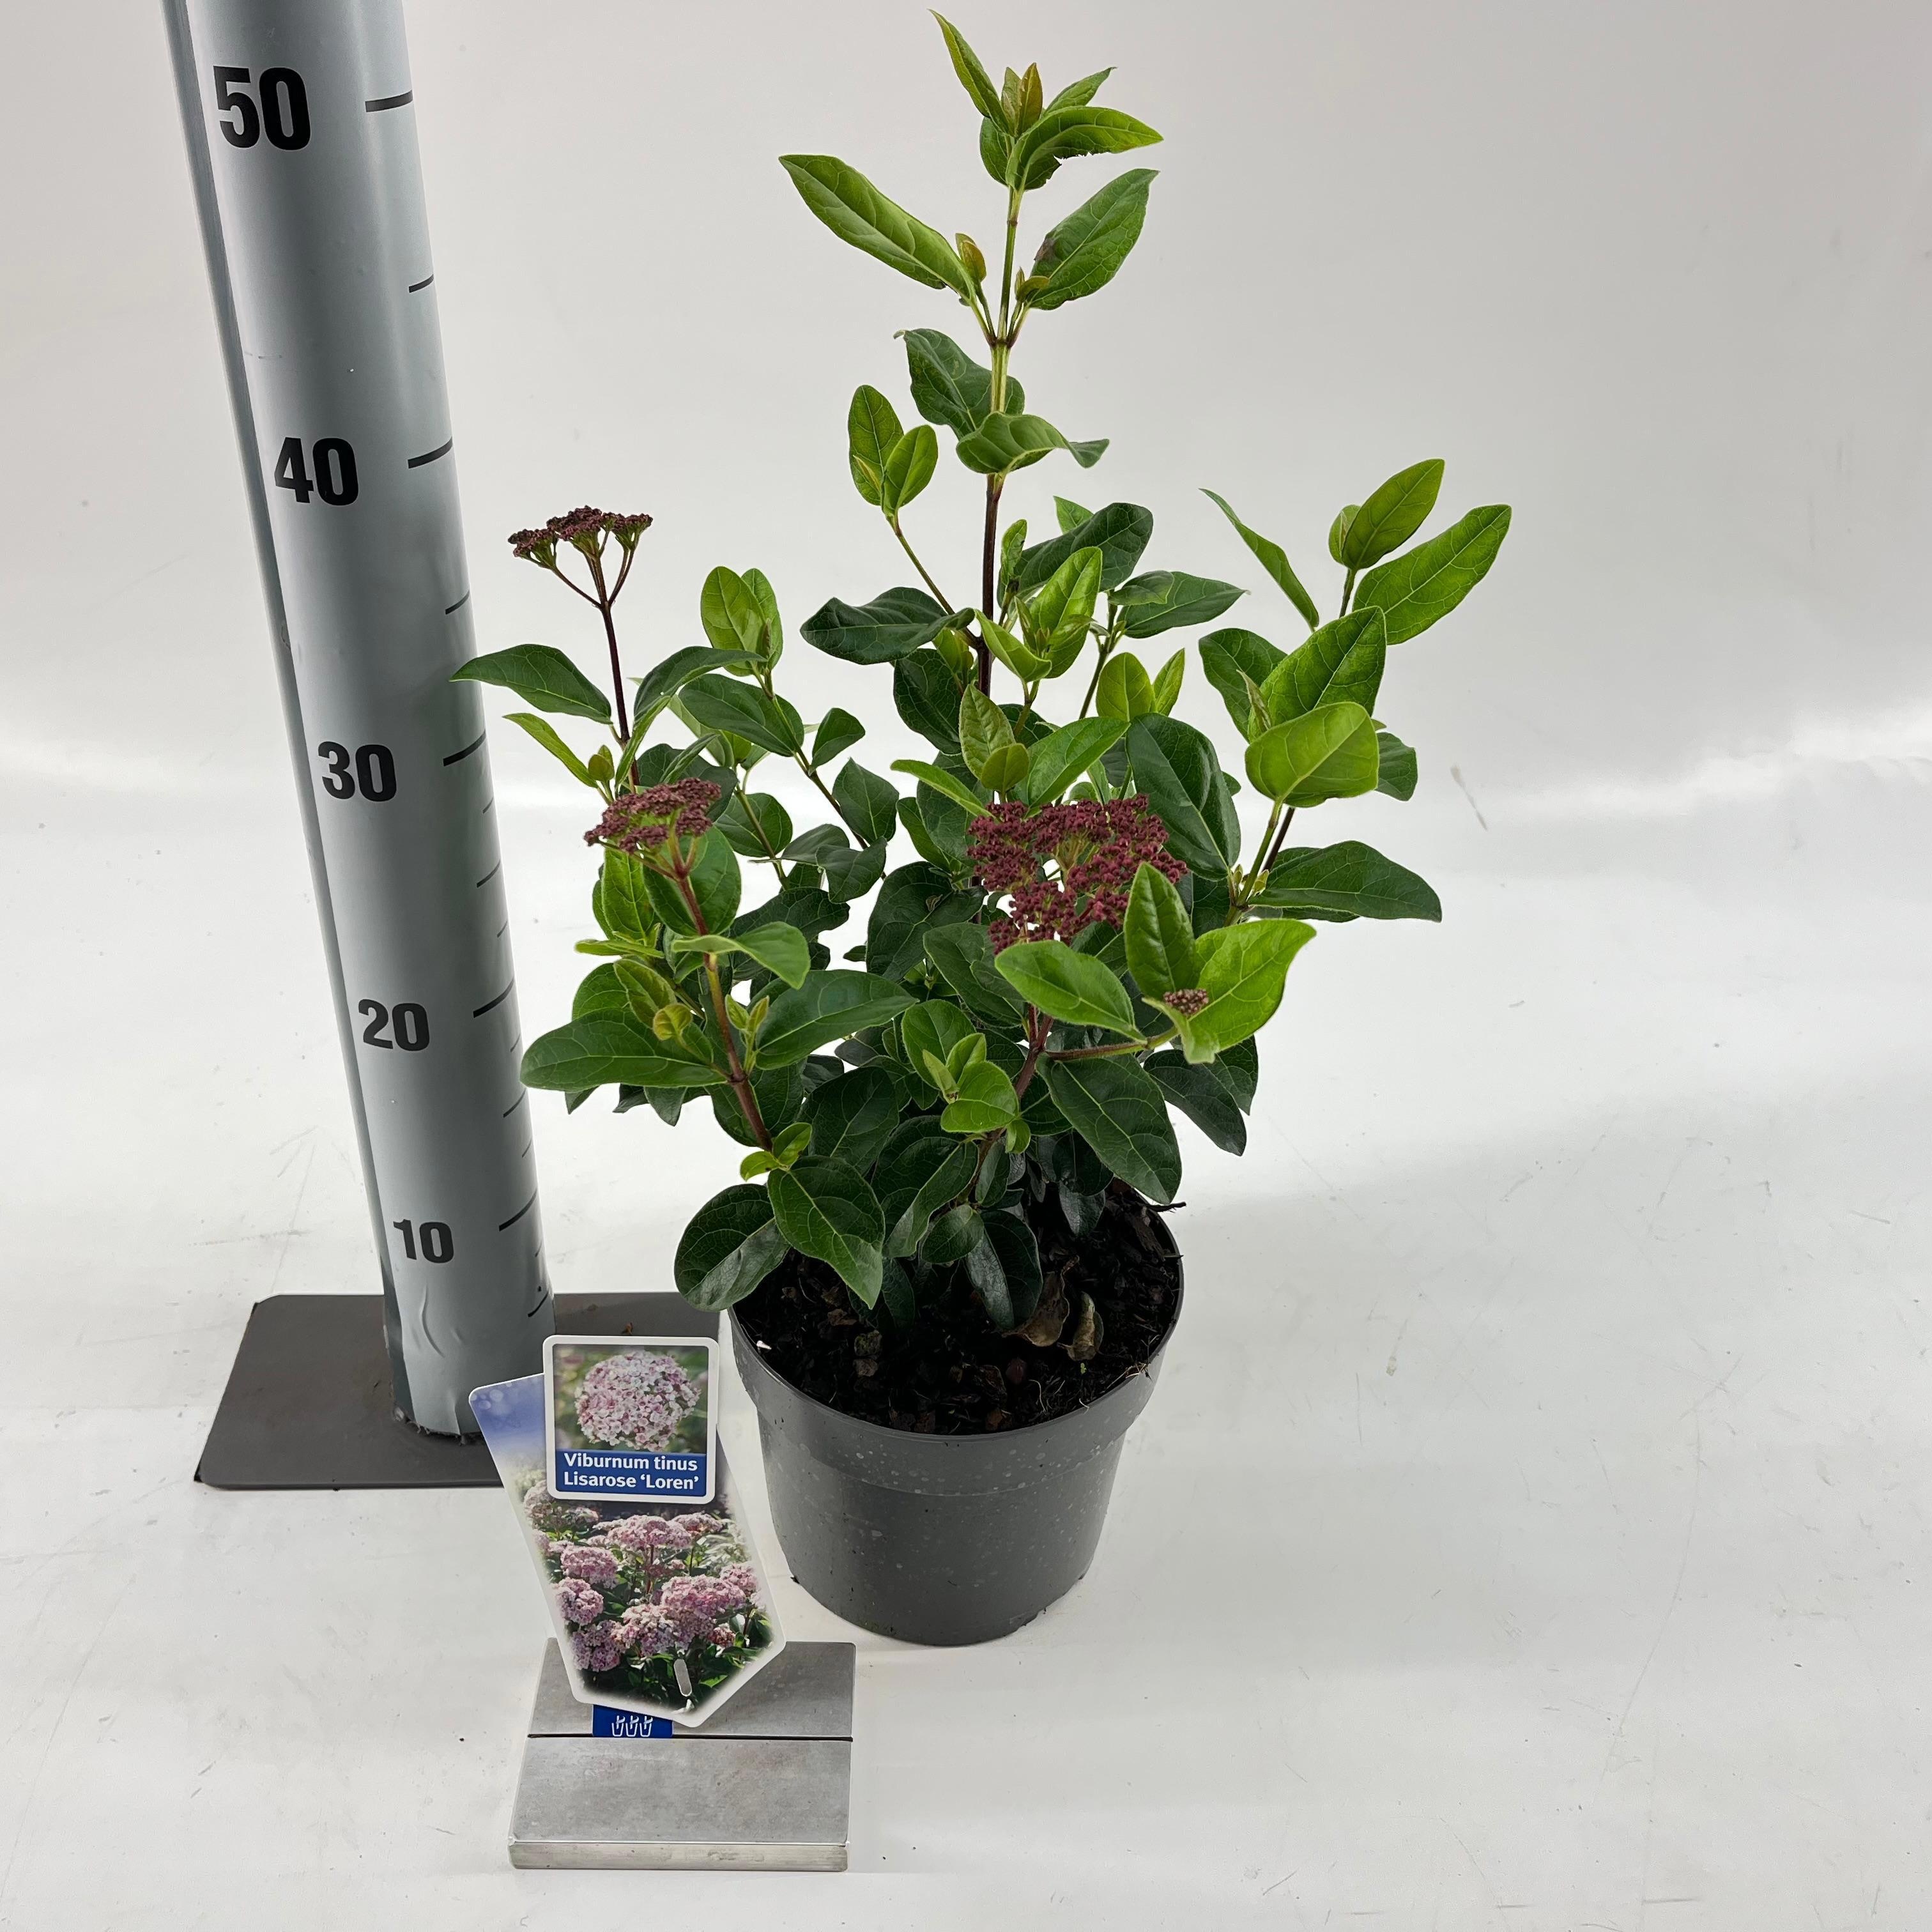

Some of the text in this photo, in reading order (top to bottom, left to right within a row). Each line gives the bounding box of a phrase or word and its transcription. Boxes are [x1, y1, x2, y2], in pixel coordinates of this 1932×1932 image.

[212, 66, 311, 151] 50
[275, 437, 359, 507] 40
[318, 741, 397, 802] 30
[358, 999, 431, 1052] 20
[393, 1218, 455, 1264] 10
[564, 1452, 698, 1471] Viburnum tinus
[564, 1471, 700, 1490] Lisarose ‘Loren’
